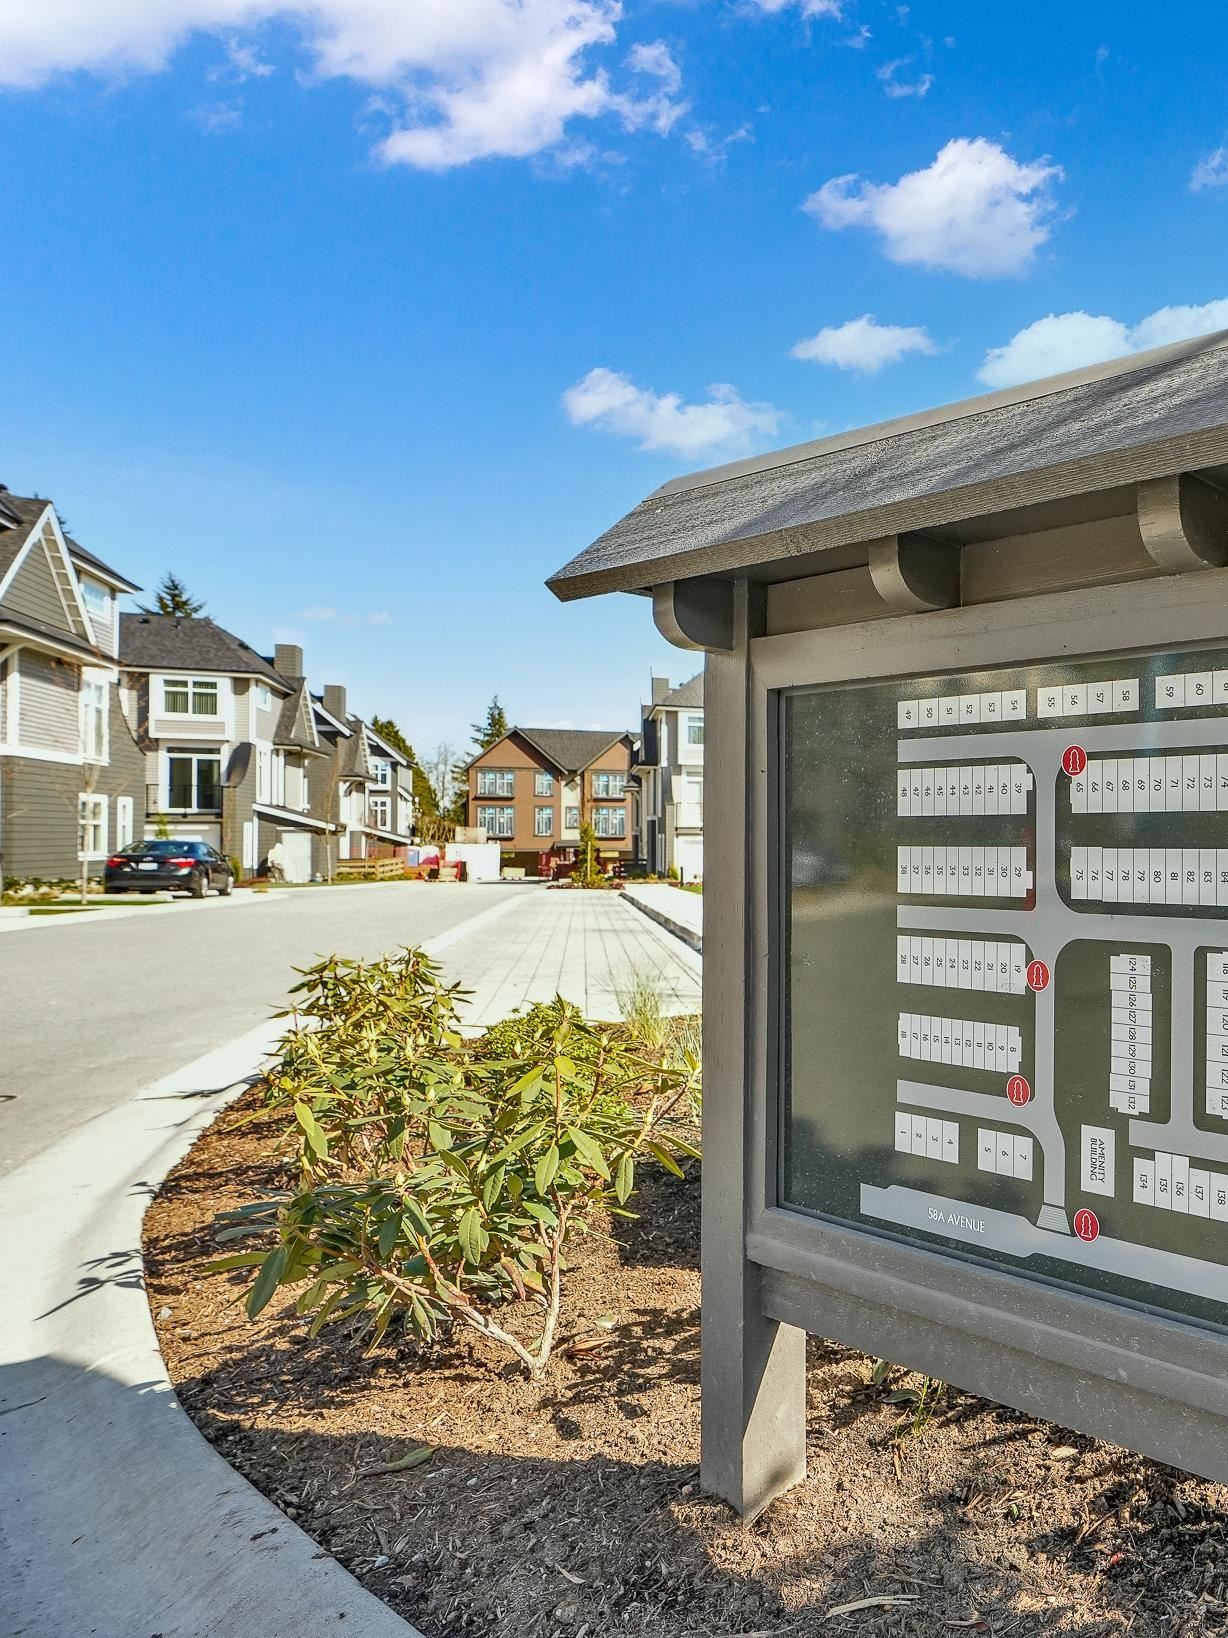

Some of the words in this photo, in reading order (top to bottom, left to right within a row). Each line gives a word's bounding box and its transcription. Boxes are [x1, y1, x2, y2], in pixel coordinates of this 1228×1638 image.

[1165, 686, 1174, 698] 59
[1195, 683, 1204, 696] 60
[1070, 695, 1078, 706] 56
[1096, 692, 1104, 703] 57
[1122, 690, 1130, 702] 58
[988, 702, 996, 713] 53
[1010, 700, 1018, 711] 54
[1047, 697, 1055, 708] 55
[905, 709, 912, 720] 49
[926, 707, 933, 719] 50
[946, 707, 953, 715] 51
[966, 704, 973, 715] 52
[987, 784, 994, 793] 41
[1014, 783, 1022, 794] 39
[1076, 782, 1084, 793] 65
[1091, 781, 1099, 793] 66
[1105, 781, 1114, 792] 67
[1121, 779, 1130, 791] 68
[1137, 779, 1146, 791] 69
[1153, 778, 1162, 792] 70
[1170, 779, 1179, 788] 71
[1186, 777, 1196, 790] 72
[1203, 776, 1212, 789] 73
[900, 786, 908, 798] 48
[913, 786, 920, 797] 47
[924, 786, 931, 797] 46
[936, 785, 944, 796] 45
[962, 784, 970, 796] 43
[975, 784, 982, 795] 42
[1001, 783, 1008, 795] 40
[912, 864, 920, 875] 37
[924, 865, 931, 876] 36
[936, 865, 944, 876] 35
[949, 865, 956, 876] 34
[962, 865, 970, 876] 33
[974, 865, 982, 877] 32
[987, 867, 995, 876] 31
[1000, 866, 1008, 878] 30
[1014, 866, 1022, 878] 29
[1075, 869, 1084, 881] 75
[1091, 870, 1099, 881] 76
[1121, 870, 1130, 881] 78
[1105, 870, 1114, 882] 77
[1137, 870, 1146, 882] 79
[1153, 870, 1162, 883] 80
[1170, 872, 1179, 881] 81
[1186, 870, 1195, 883] 82
[1203, 871, 1212, 883] 83
[912, 955, 919, 966] 27
[924, 956, 931, 967] 26
[936, 957, 943, 968] 25
[949, 958, 956, 969] 24
[962, 959, 969, 970] 23
[974, 960, 982, 971] 22
[986, 962, 994, 971] 21
[1128, 957, 1137, 972] 124
[1000, 962, 1008, 974] 20
[1014, 965, 1022, 973] 19
[1128, 976, 1137, 990] 125
[1128, 993, 1137, 1008] 126
[1128, 1010, 1137, 1024] 127
[912, 1032, 919, 1040] 17
[933, 1035, 940, 1043] 15
[1128, 1027, 1137, 1041] 128
[954, 1038, 961, 1046] 13
[965, 1039, 972, 1048] 12
[986, 1042, 994, 1051] 10
[1128, 1044, 1137, 1058] 129
[1128, 1060, 1136, 1075] 130
[1128, 1079, 1136, 1091] 131
[1128, 1096, 1136, 1110] 132
[1090, 1137, 1098, 1181] BUILDING
[1098, 1138, 1106, 1184] AMENITY
[1139, 1173, 1148, 1189] 134
[1159, 1178, 1168, 1194] 135
[1175, 1181, 1184, 1197] 136
[1194, 1185, 1204, 1201] 137
[1217, 1189, 1226, 1206] 138
[928, 1207, 945, 1223] 58A
[947, 1213, 985, 1233] AVENUE
